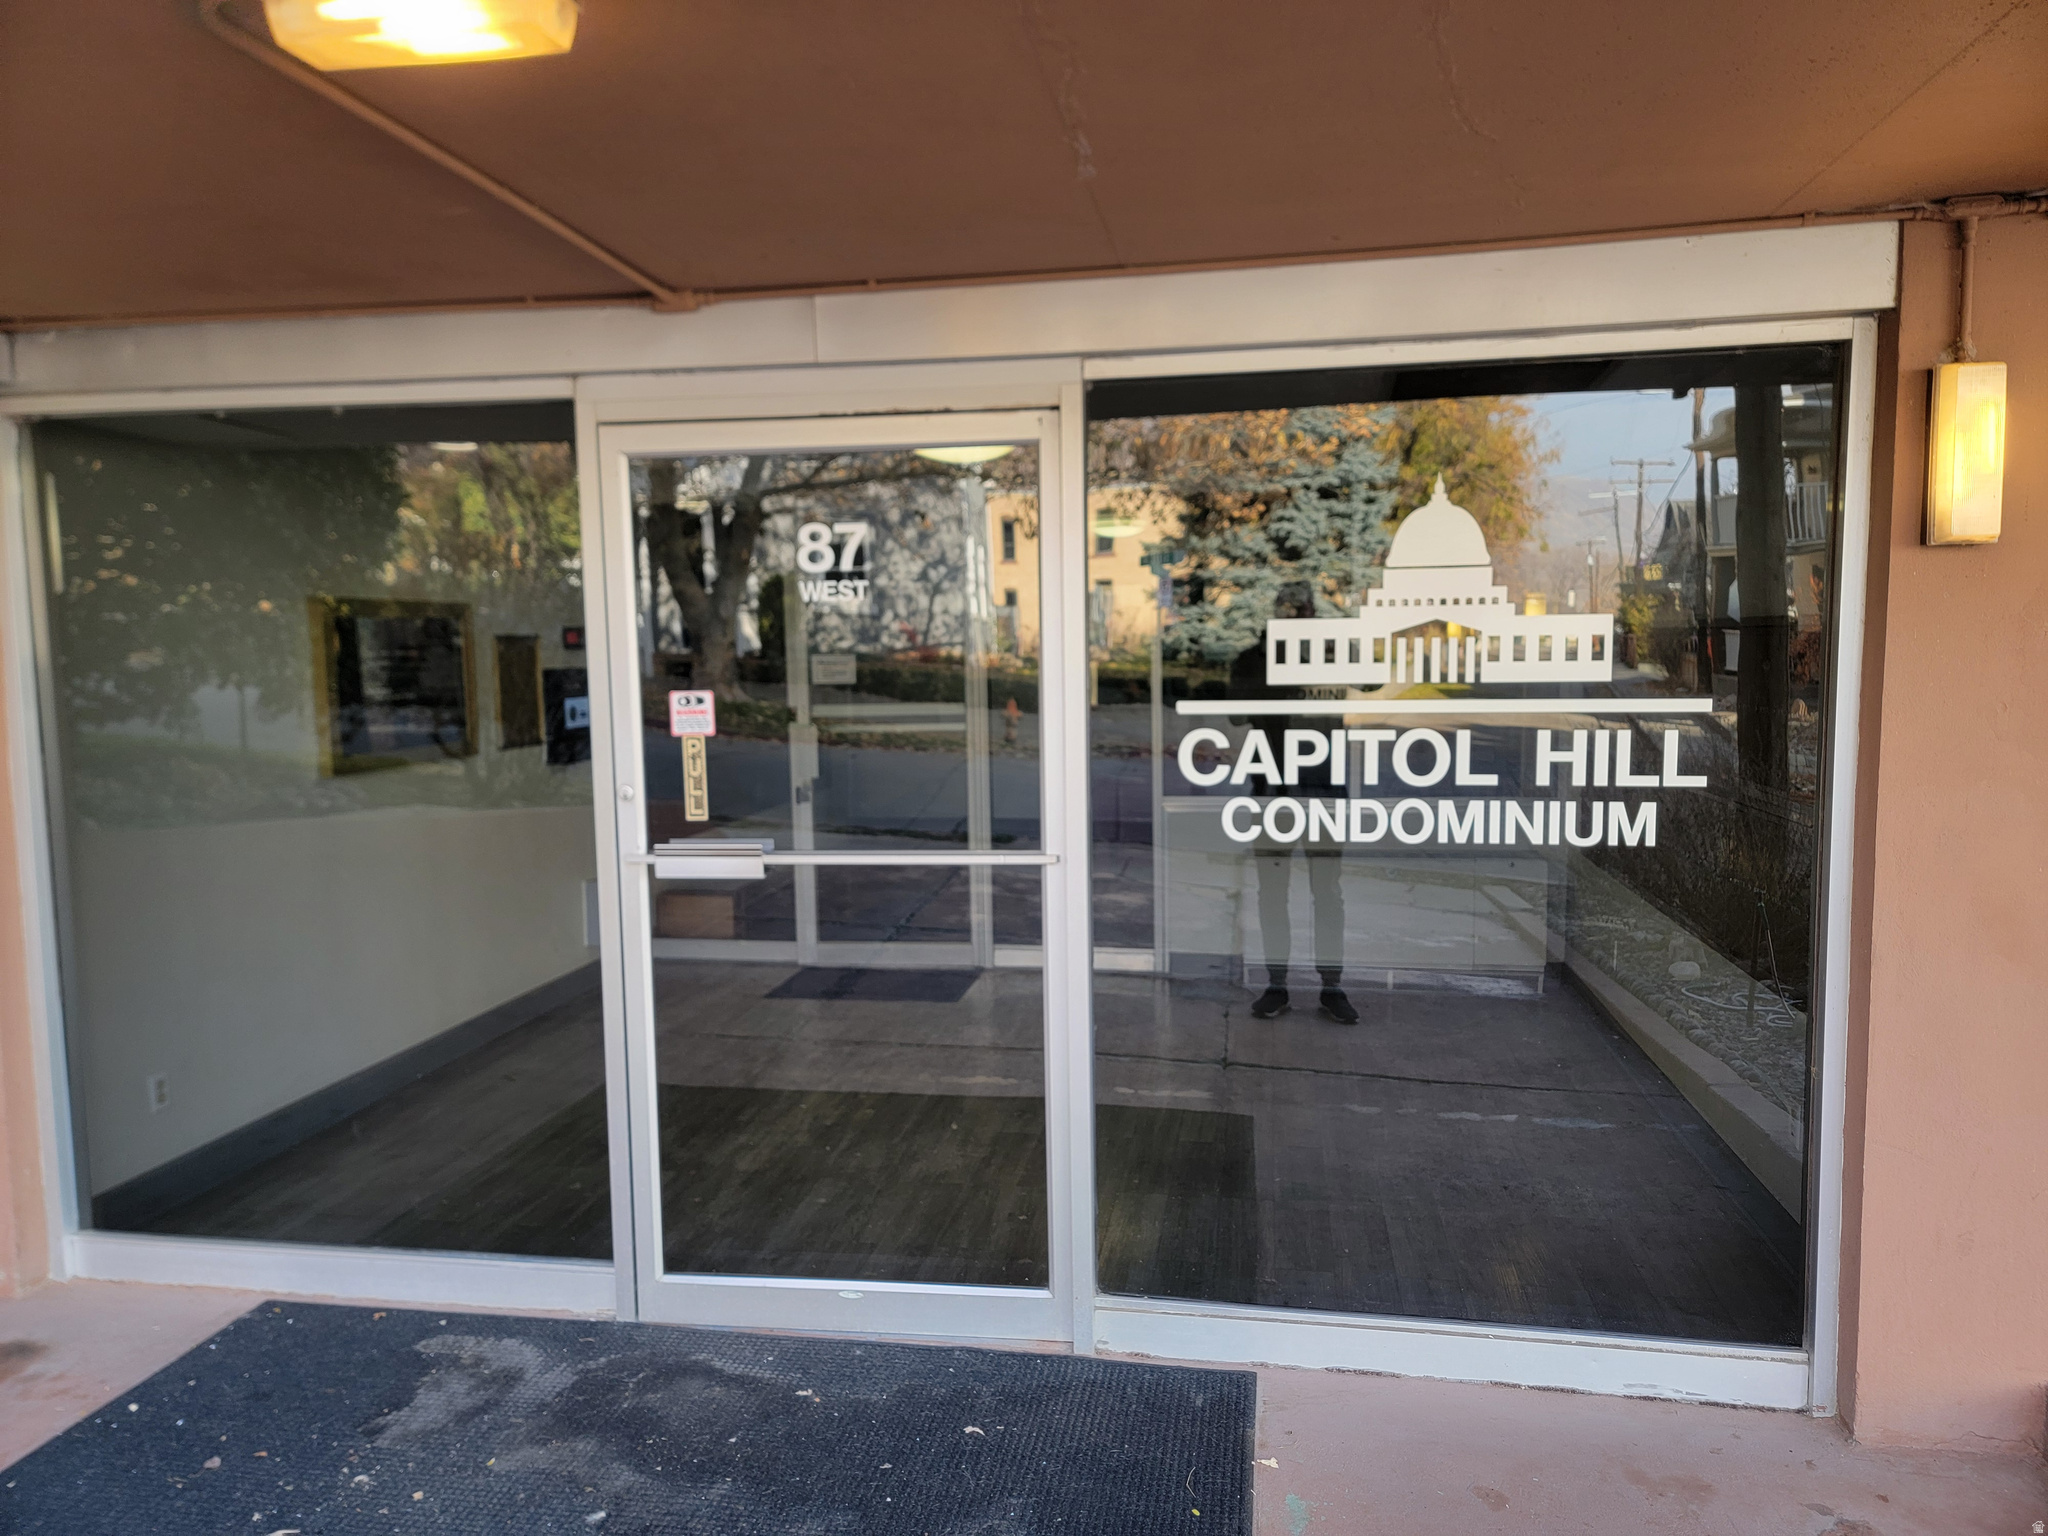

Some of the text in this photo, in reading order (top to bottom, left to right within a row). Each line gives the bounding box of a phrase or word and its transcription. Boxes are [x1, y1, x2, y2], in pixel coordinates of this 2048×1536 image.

[797, 522, 868, 573] 87
[798, 579, 870, 602] WEST
[686, 738, 704, 815] PULL
[1177, 727, 1708, 788] CAPITOL HILL
[1221, 796, 1657, 848] CONDOMINIUM
